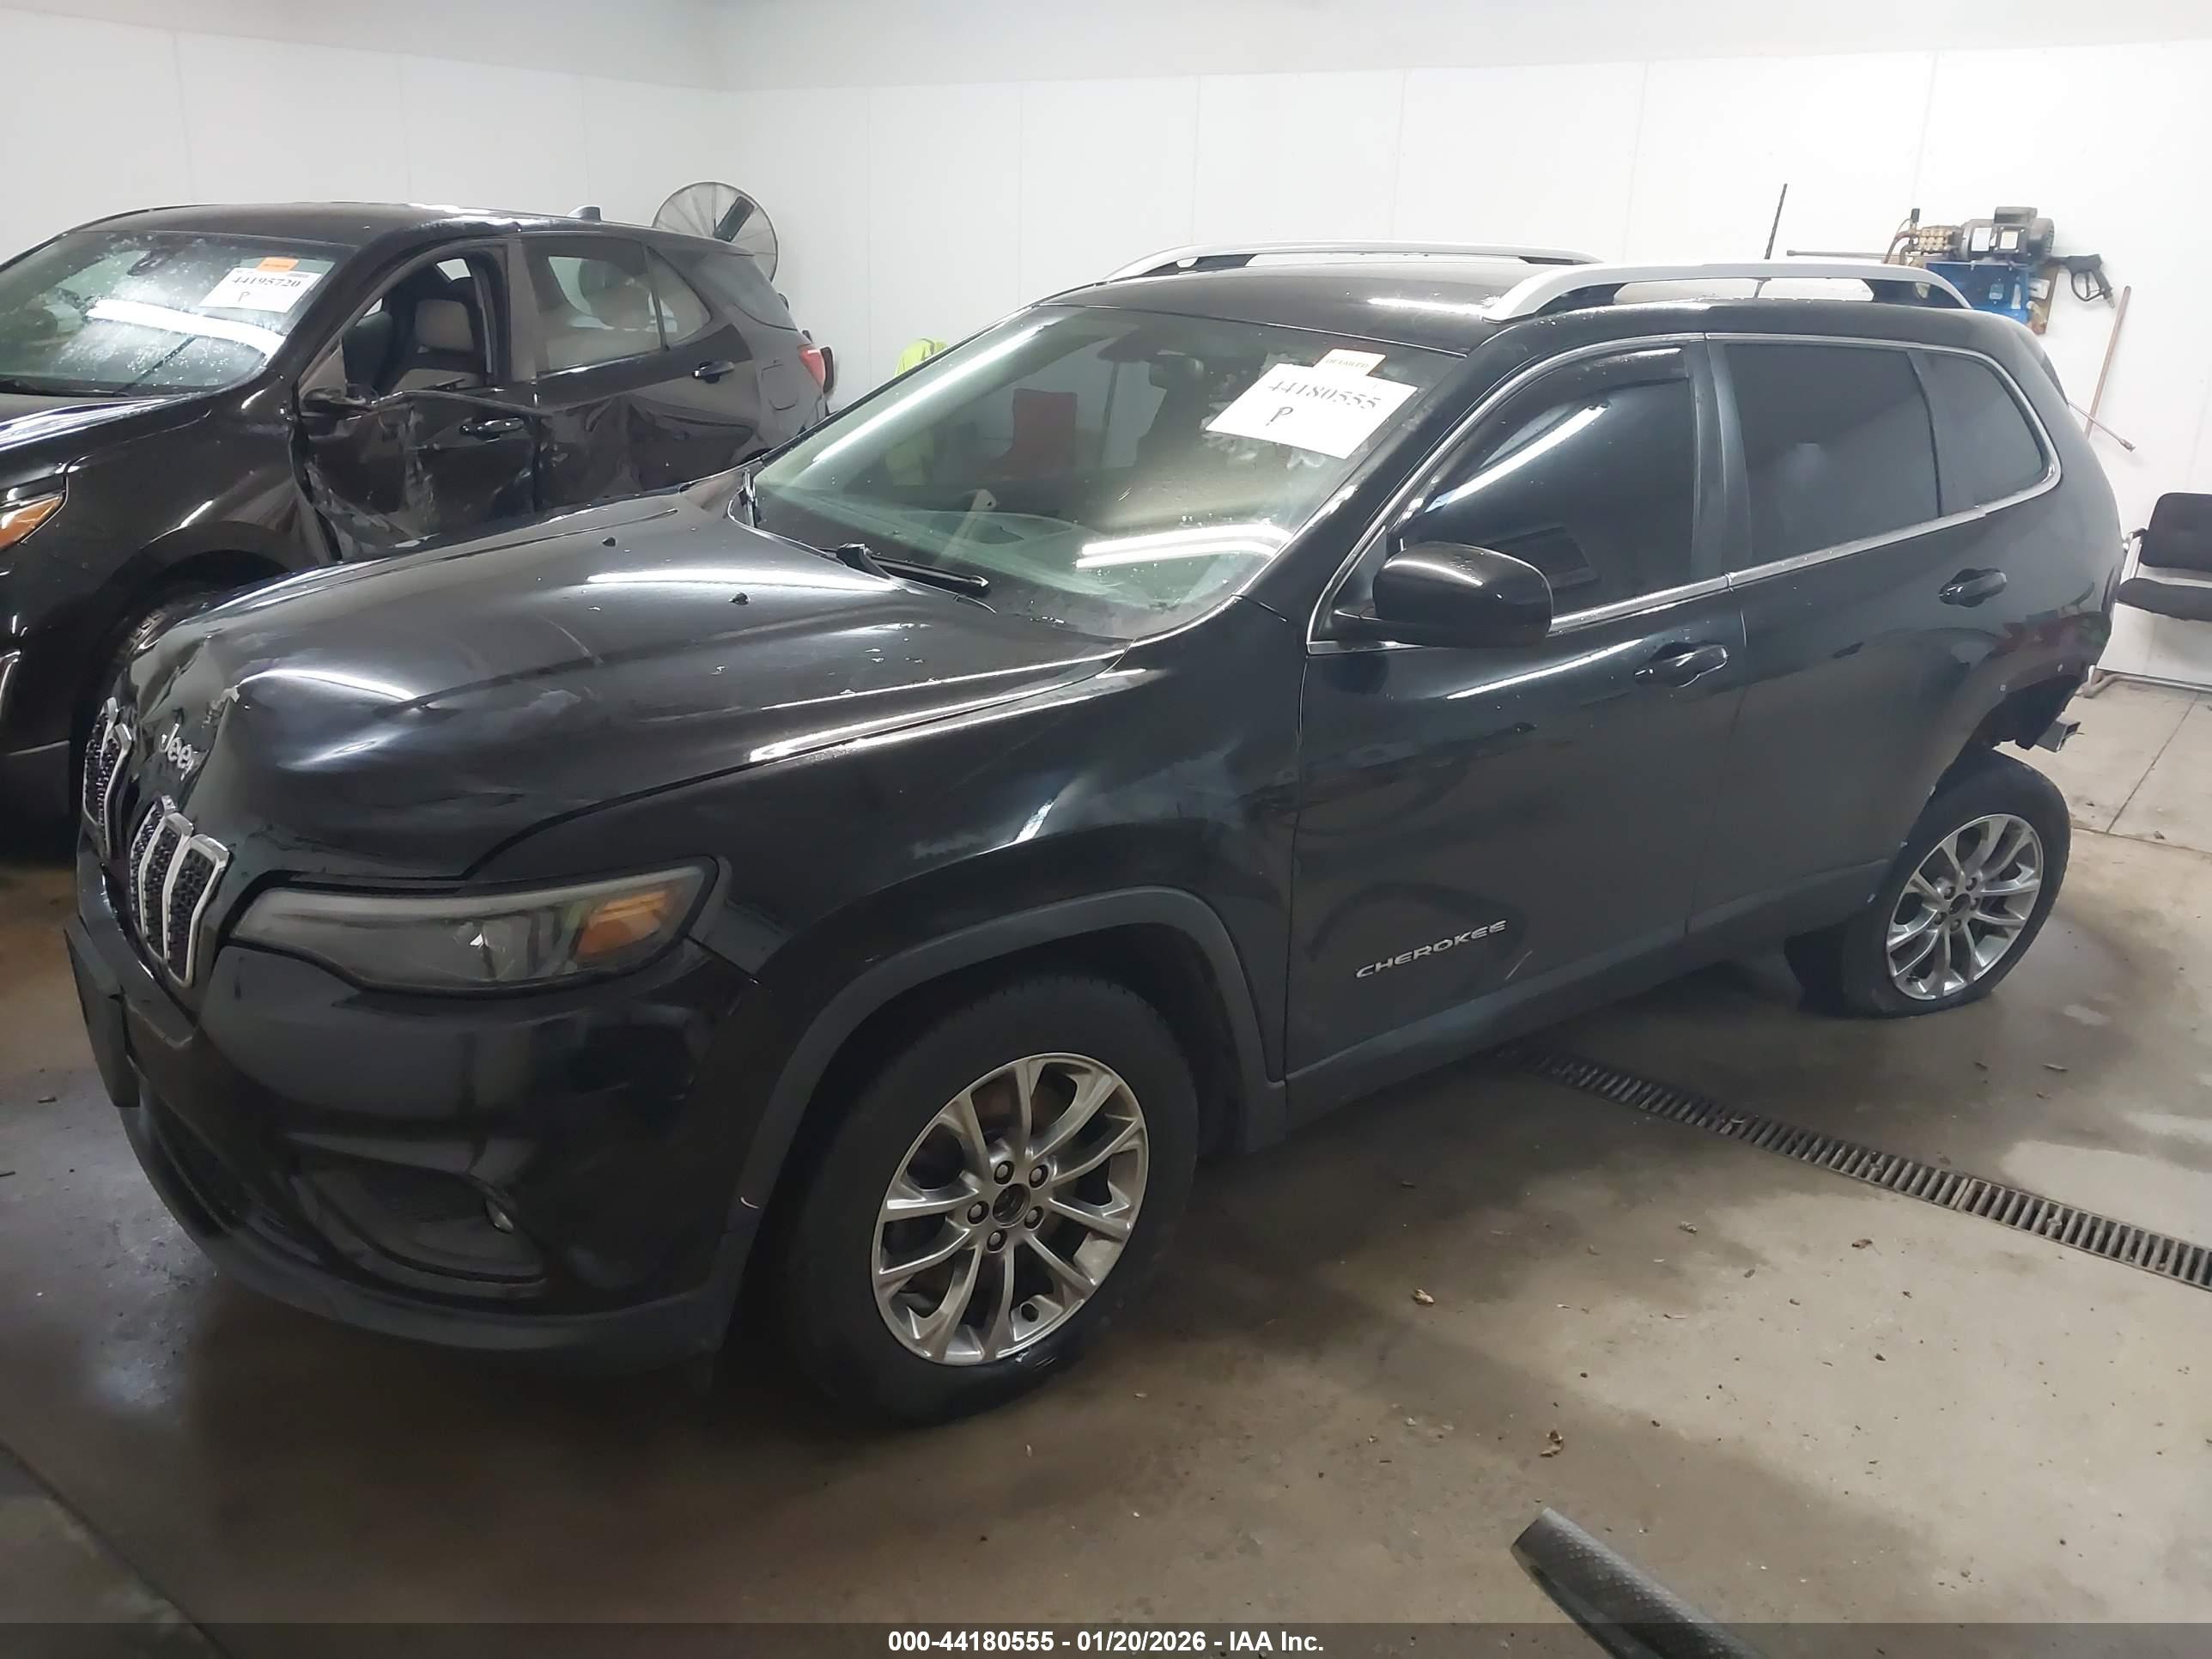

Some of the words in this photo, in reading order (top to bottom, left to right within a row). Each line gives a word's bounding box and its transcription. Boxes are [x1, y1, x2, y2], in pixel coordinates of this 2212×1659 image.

[232, 276, 301, 288] 44195720
[1325, 358, 1370, 368] DETAILED
[1267, 380, 1382, 410] 44180555
[159, 723, 194, 781] Jeep
[1355, 920, 1507, 978] CHEROKEE
